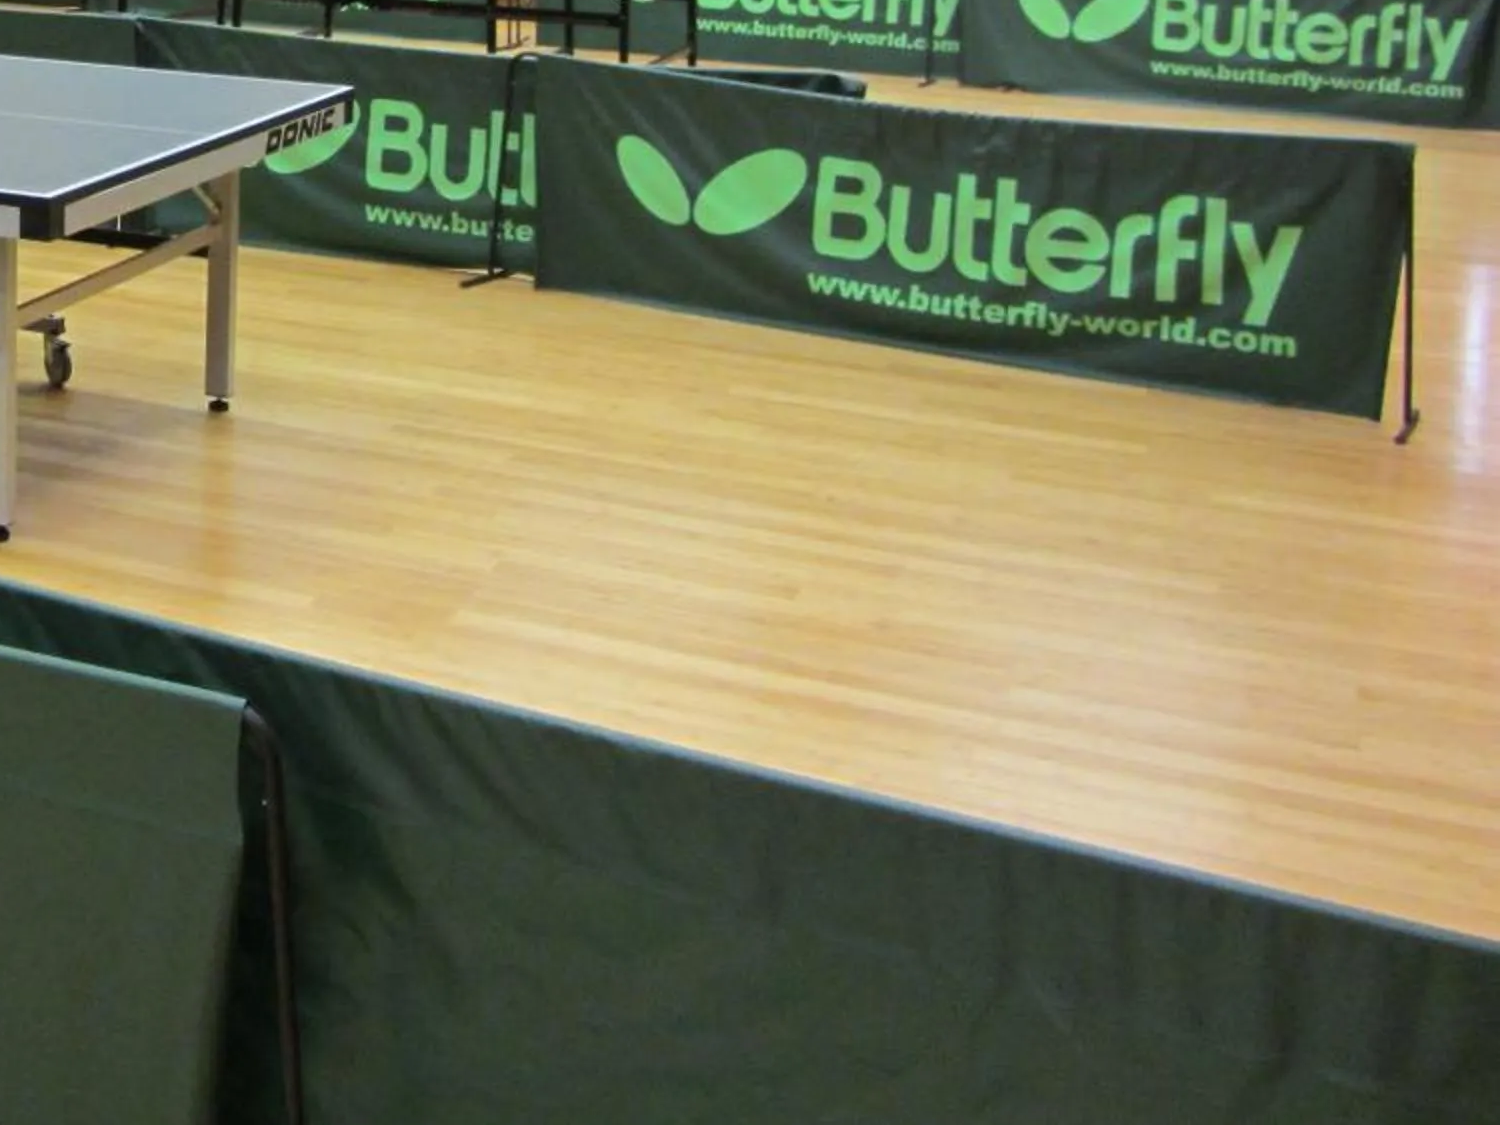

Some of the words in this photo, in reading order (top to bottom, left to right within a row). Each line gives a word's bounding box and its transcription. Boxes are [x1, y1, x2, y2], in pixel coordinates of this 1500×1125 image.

[1149, 59, 1465, 99] www.butterfly-world.com
[264, 106, 337, 156] DONIC
[364, 202, 534, 242] www.bute
[812, 155, 1303, 327] Butterfly
[806, 271, 1297, 358] www.butterfly-world.com
